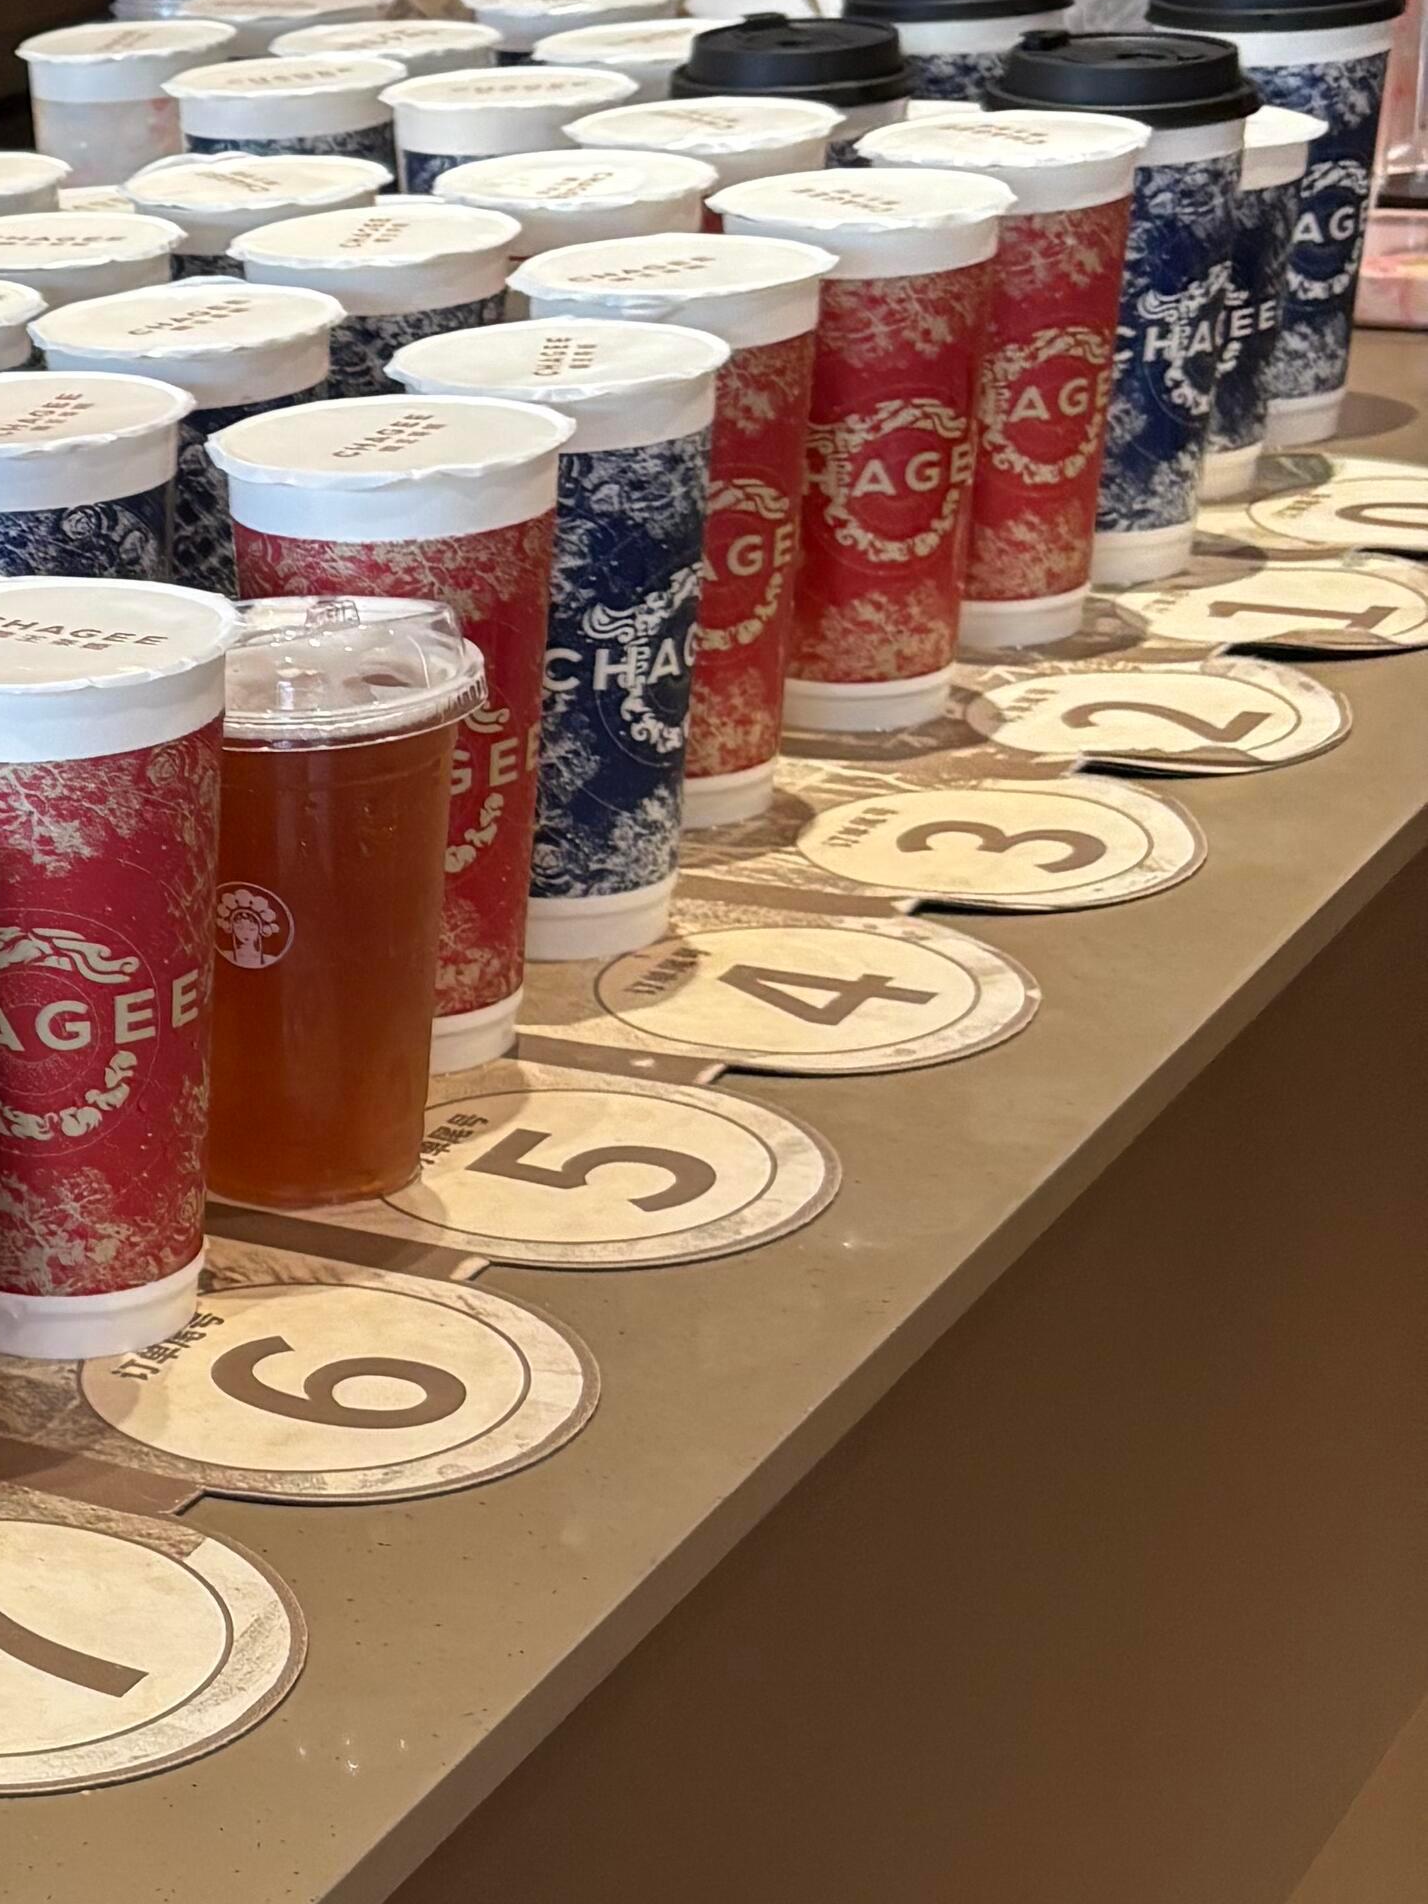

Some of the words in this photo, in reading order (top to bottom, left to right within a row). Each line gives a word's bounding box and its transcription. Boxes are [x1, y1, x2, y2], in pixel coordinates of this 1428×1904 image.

[1207, 600, 1401, 633] 1
[543, 623, 696, 693] CHA
[1061, 701, 1273, 744] 2
[896, 820, 1108, 875] 3
[716, 964, 940, 1027] 4
[466, 1128, 717, 1213] 5
[211, 1334, 468, 1430] 6
